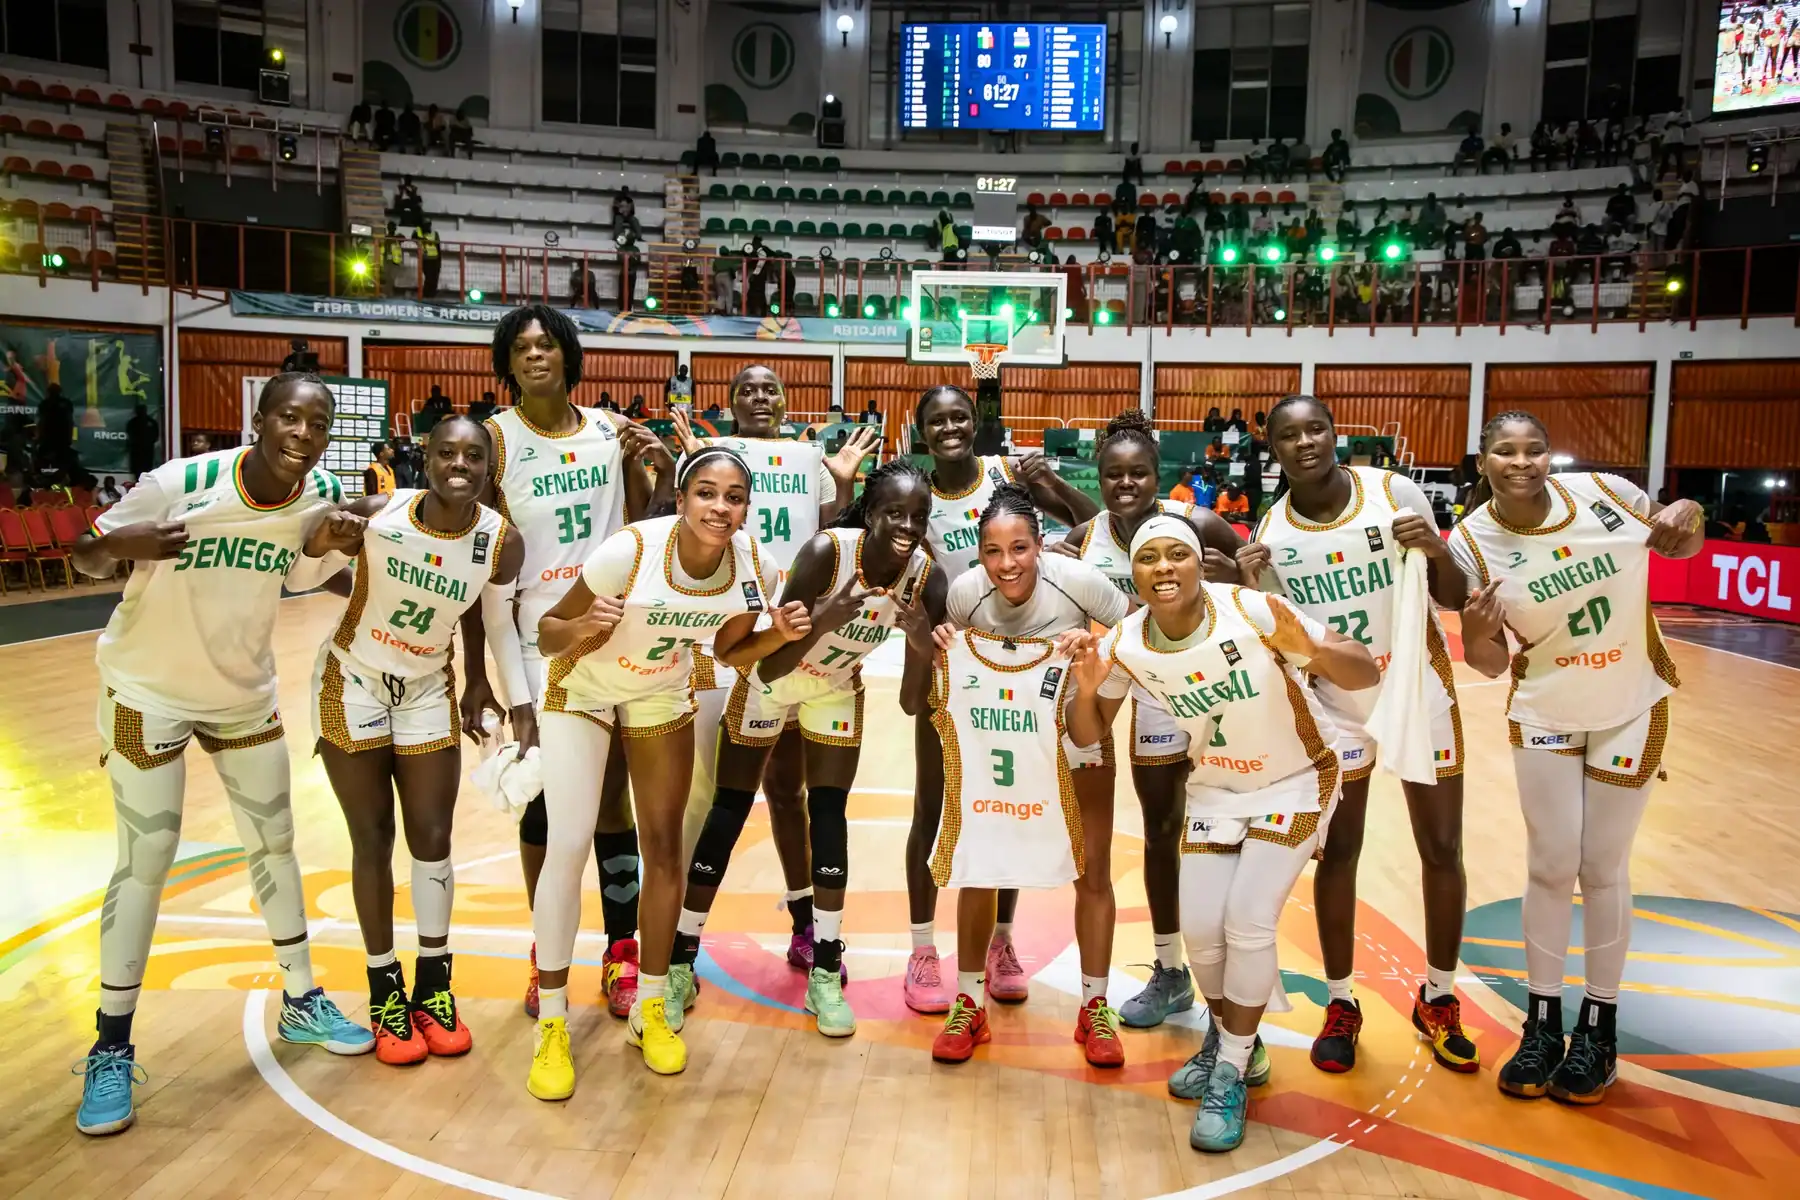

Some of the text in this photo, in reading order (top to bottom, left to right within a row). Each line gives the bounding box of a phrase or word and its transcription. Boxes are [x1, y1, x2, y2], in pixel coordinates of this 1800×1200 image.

[983, 83, 1020, 101] 61:27
[976, 177, 1017, 192] 61:27
[313, 302, 352, 315] FIBA
[358, 303, 434, 319] WOMEN'S
[832, 323, 898, 338] ABIDJAN
[531, 464, 610, 498] SENEGAL
[750, 471, 809, 495] ENEGAL
[554, 503, 592, 545] 35
[757, 506, 792, 544] 34
[386, 556, 468, 603] SENEGAL
[1286, 557, 1394, 606] SENEGAL
[1527, 552, 1622, 603] SENEGAL
[1711, 553, 1792, 611] TCL
[388, 599, 436, 635] 24
[1328, 609, 1373, 646] 22
[819, 645, 864, 670] 77
[749, 718, 781, 729] 1XBET
[1139, 733, 1175, 745] 1XBET
[1530, 733, 1573, 746] 1XBET
[990, 748, 1015, 787] 3
[972, 799, 1043, 820] orange
